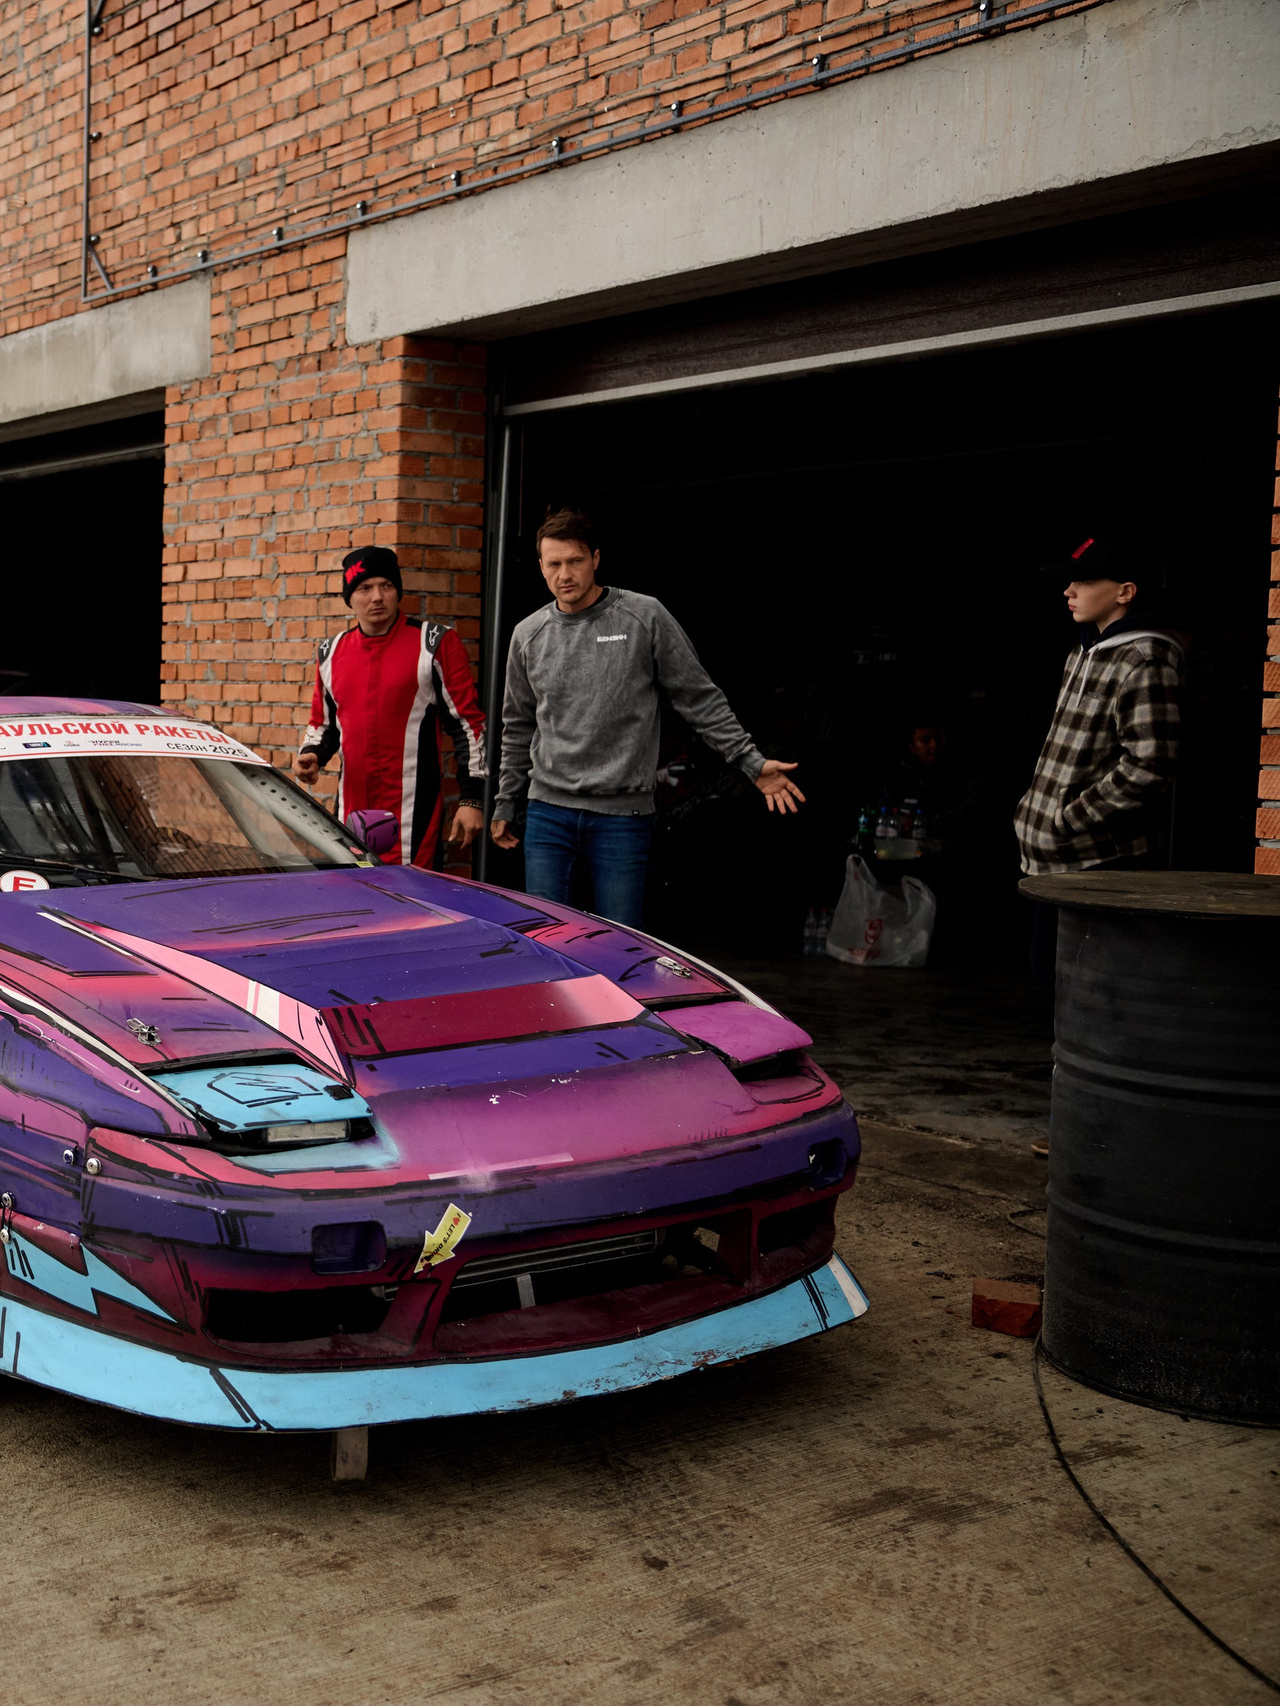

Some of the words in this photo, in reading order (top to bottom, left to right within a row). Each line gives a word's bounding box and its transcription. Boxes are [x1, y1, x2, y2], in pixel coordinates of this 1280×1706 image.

[134, 723, 231, 745] РАКЕТЫ
[166, 742, 208, 753] СЕЗОН
[211, 744, 249, 758] 2025
[443, 1224, 455, 1244] LET'S
